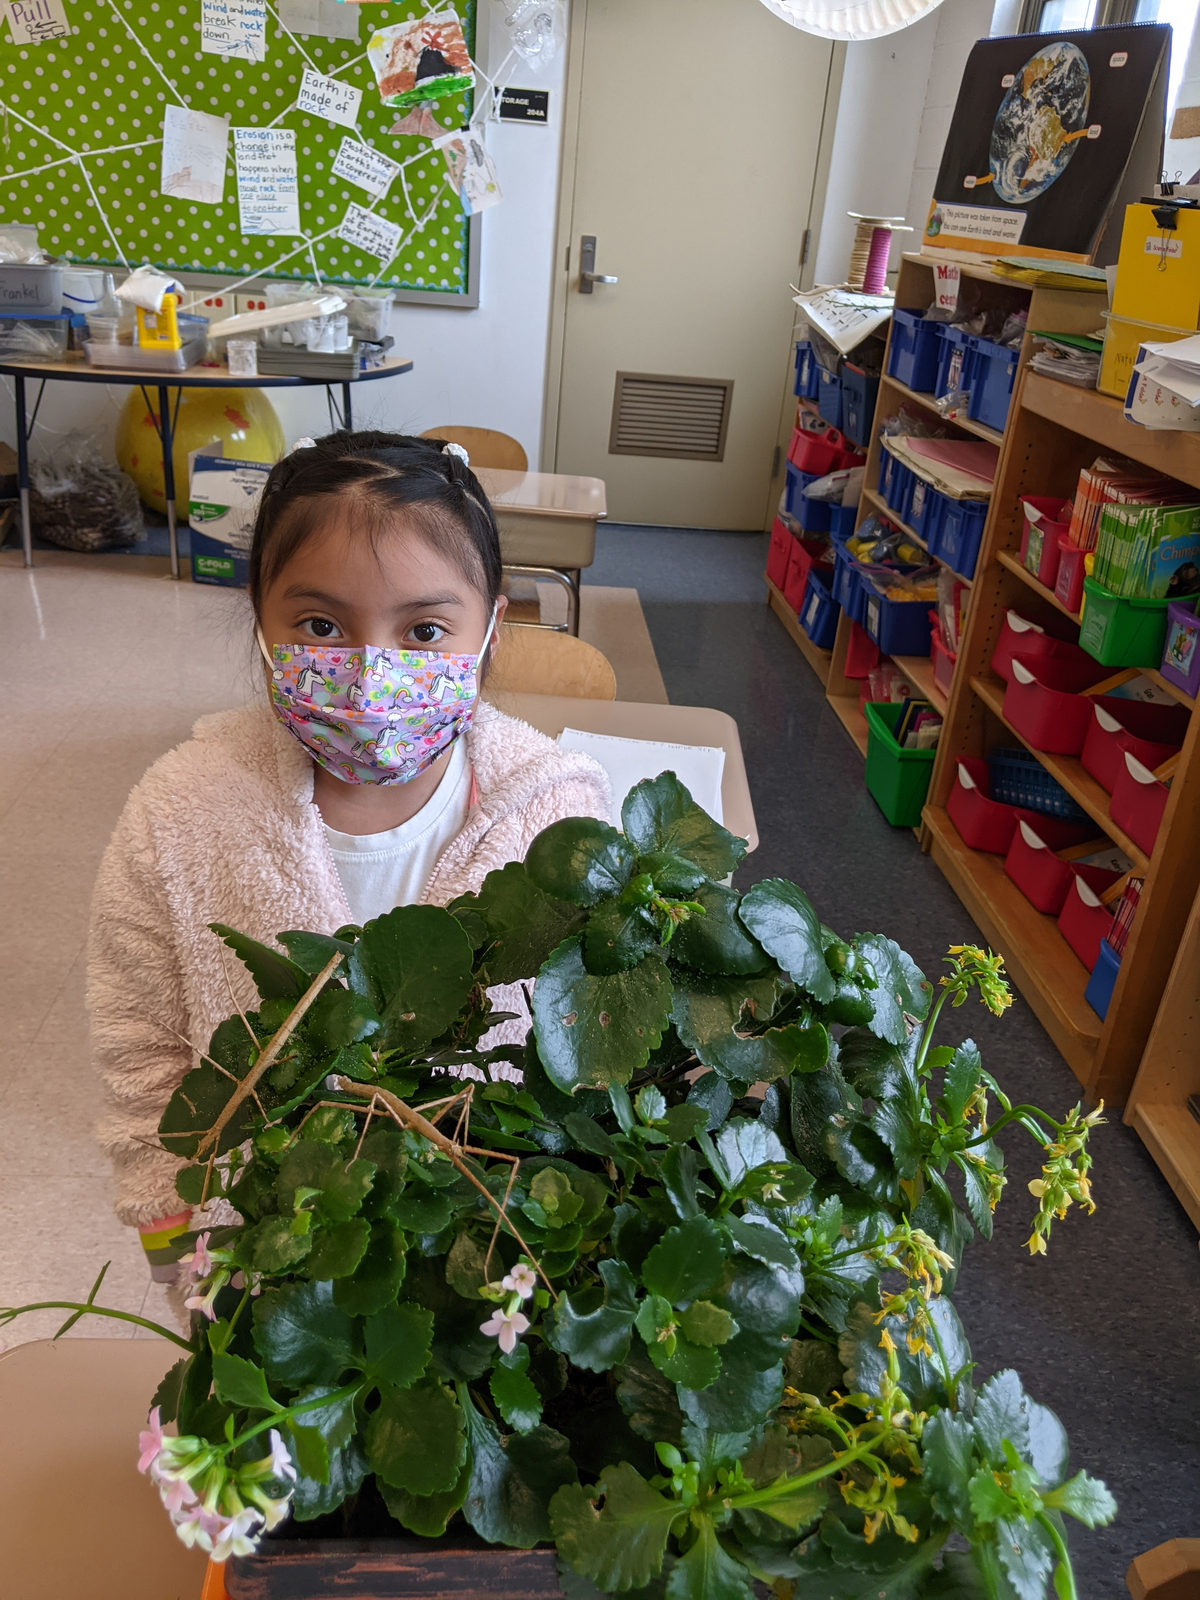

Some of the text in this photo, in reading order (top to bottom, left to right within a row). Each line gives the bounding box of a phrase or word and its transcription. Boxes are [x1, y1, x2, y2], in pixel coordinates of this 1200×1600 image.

[11, 0, 51, 24] Pull
[229, 5, 244, 16] and
[203, 14, 263, 32] break rock
[203, 28, 230, 40] down
[305, 72, 355, 101] Earth is
[300, 89, 350, 114] made of
[501, 96, 530, 106] TORAGE
[236, 129, 274, 140] Erosion
[276, 132, 285, 140] is
[344, 140, 364, 154] Most
[345, 163, 378, 183] covered
[349, 205, 368, 221] The
[936, 265, 959, 280] Math
[1160, 543, 1200, 562] Chimp
